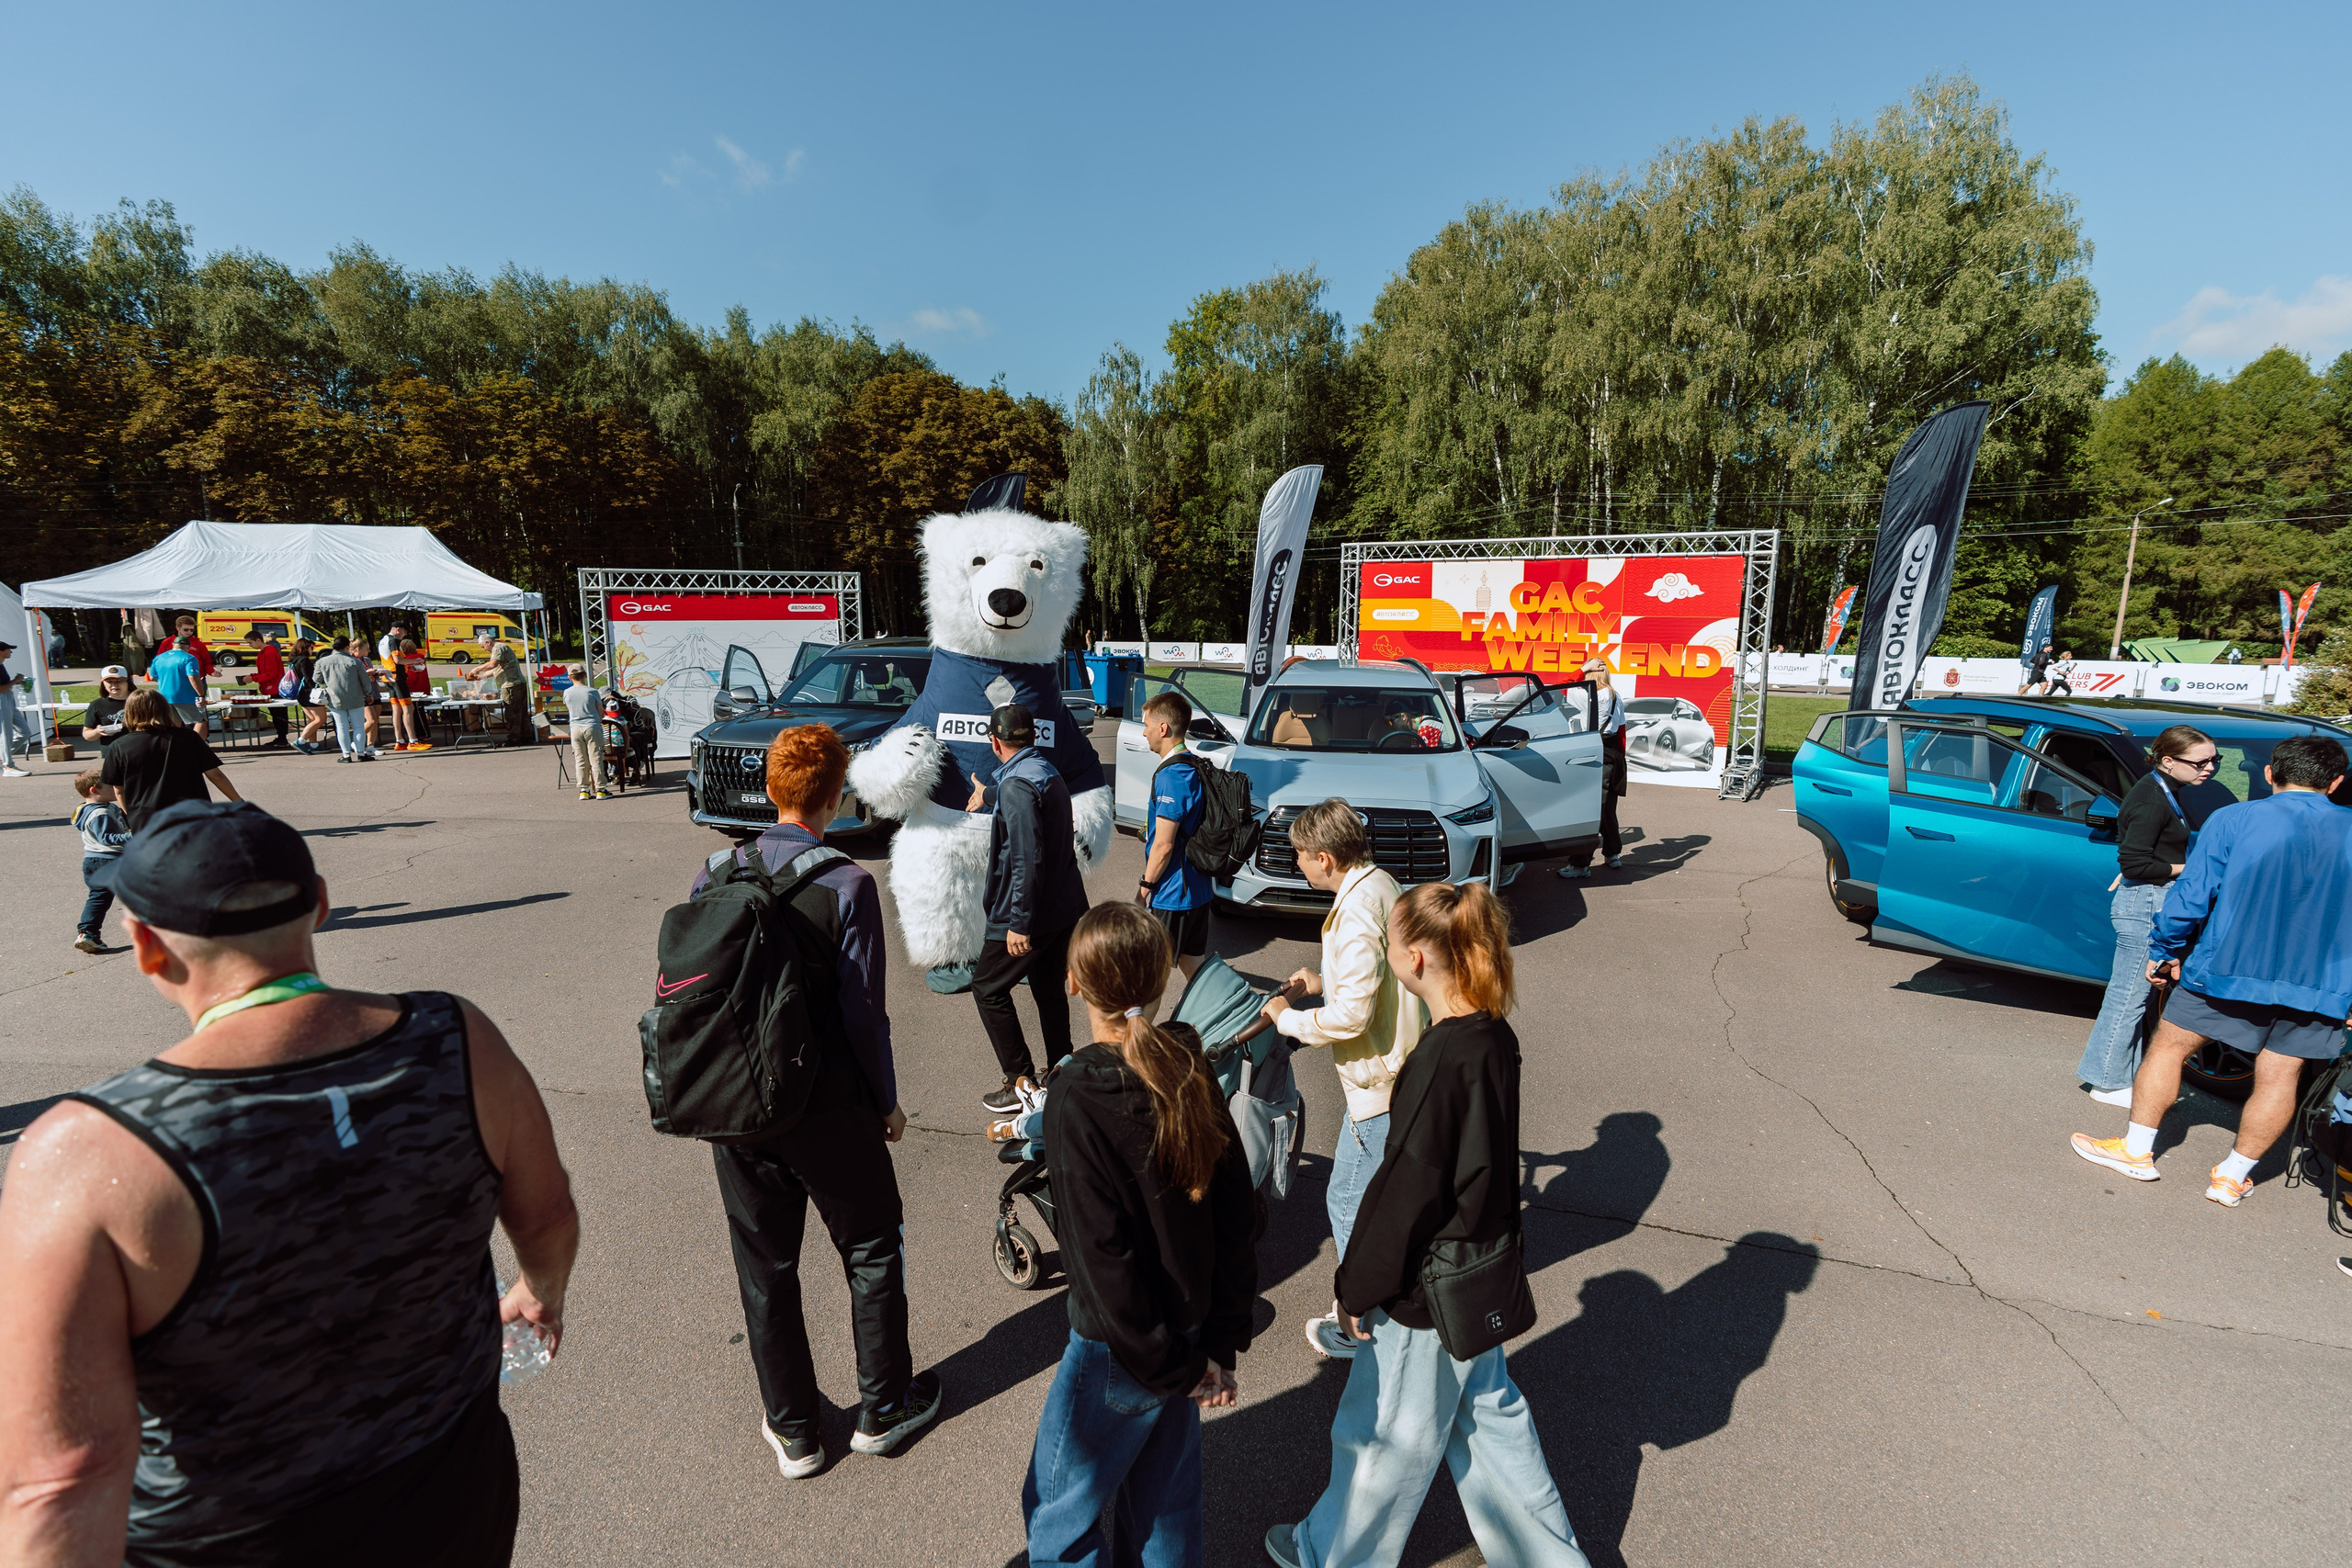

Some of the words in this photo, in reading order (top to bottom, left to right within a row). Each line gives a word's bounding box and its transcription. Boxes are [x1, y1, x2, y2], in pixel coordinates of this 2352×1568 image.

[1510, 581, 1606, 614] GAC
[1461, 611, 1623, 643] FAMILY
[1883, 543, 1928, 705] АВТОКЛАСС
[1485, 640, 1723, 678] WEEKEND
[2066, 671, 2092, 680] CLUB
[2187, 682, 2248, 691] ЭВОКОМ
[942, 719, 1051, 740] АВТОСС
[741, 795, 766, 804] GS8
